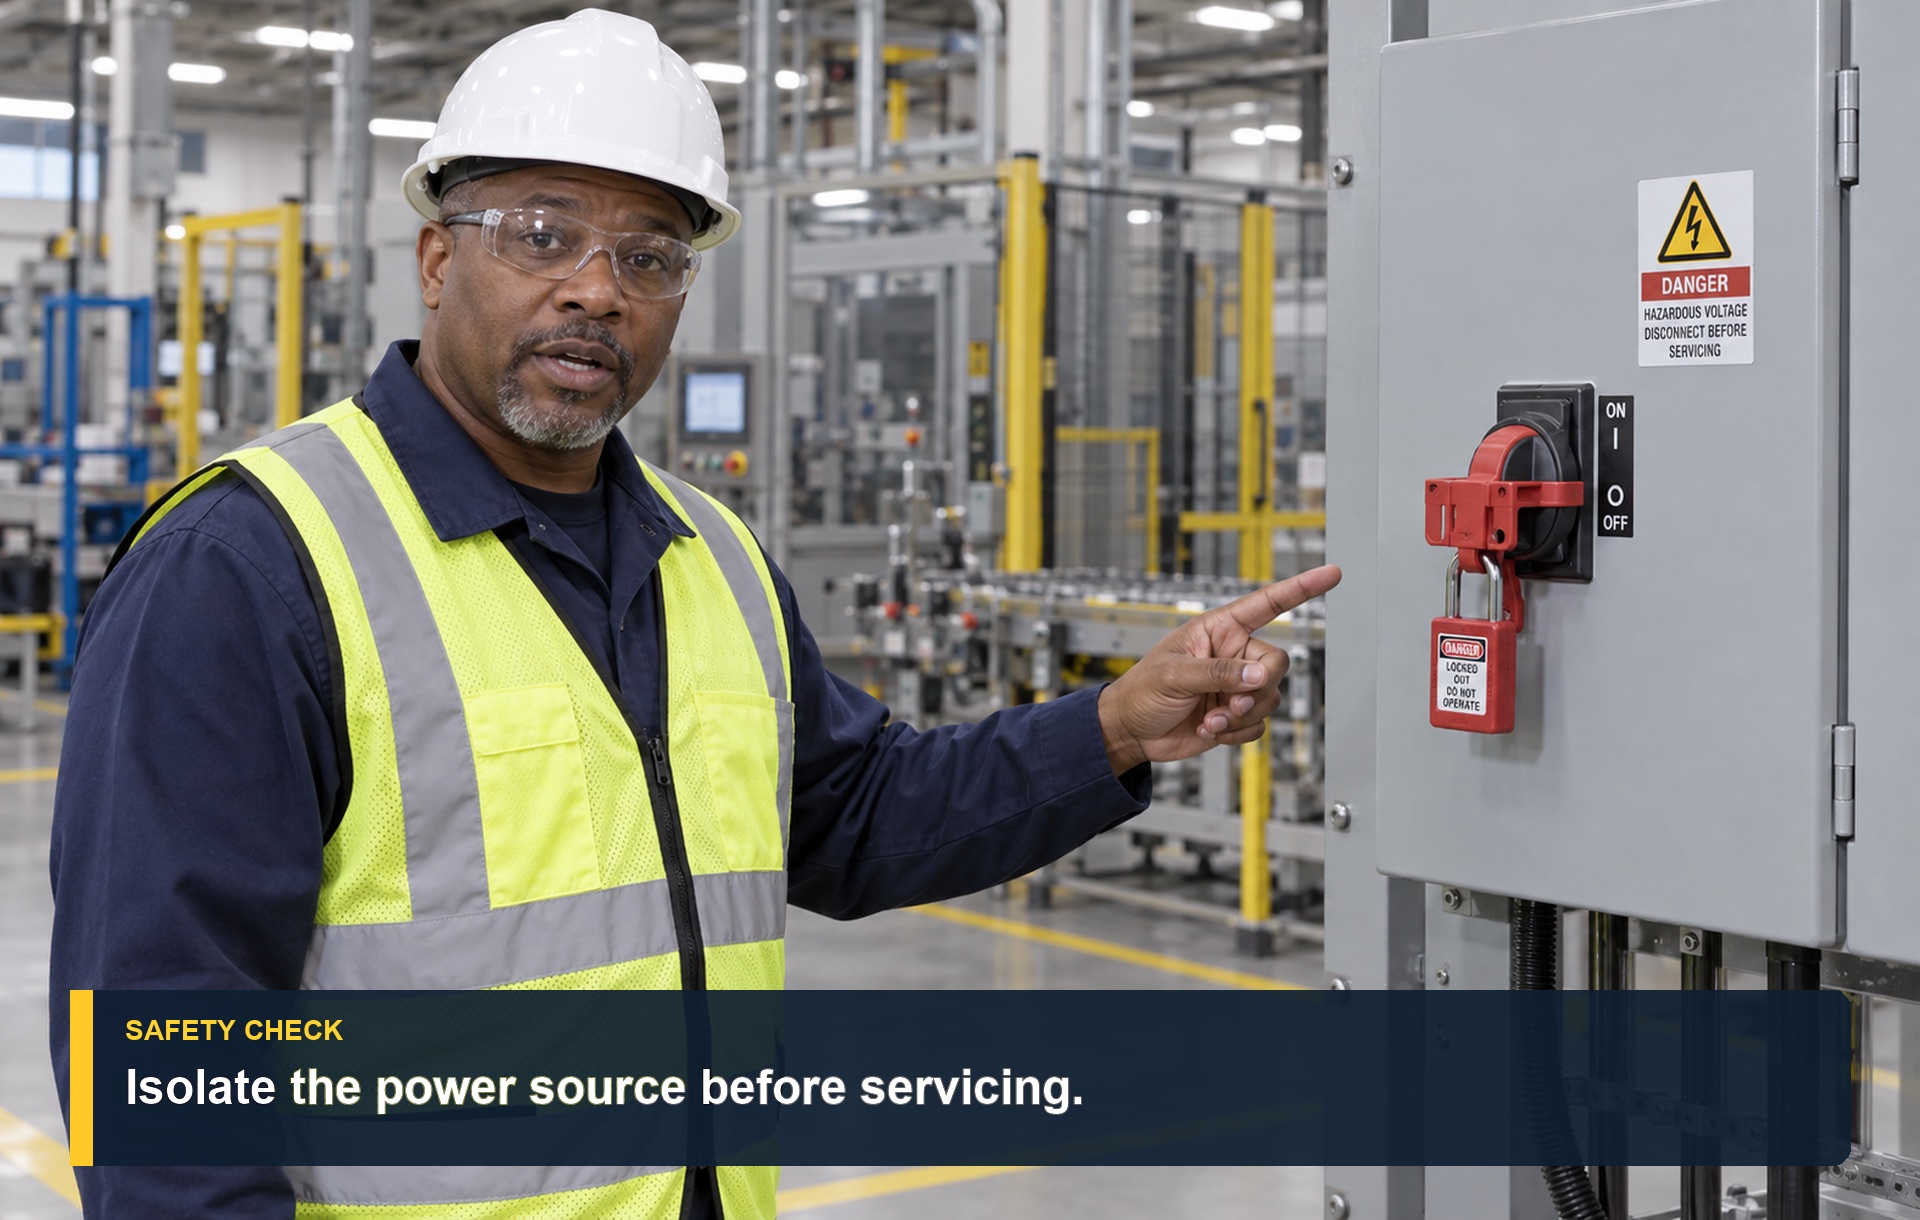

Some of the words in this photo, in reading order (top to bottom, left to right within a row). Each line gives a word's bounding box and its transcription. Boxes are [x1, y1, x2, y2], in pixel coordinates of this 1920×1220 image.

[1662, 274, 1729, 295] DANGER
[1644, 305, 1702, 321] HAZARDOUS
[1704, 303, 1748, 319] VOLTAGE
[1644, 325, 1705, 341] DISCONNECT
[1708, 323, 1747, 338] BEFORE
[1669, 343, 1721, 359] SERVICING
[1606, 402, 1626, 418] ON
[1603, 514, 1629, 531] OFF
[1447, 686, 1458, 696] DO
